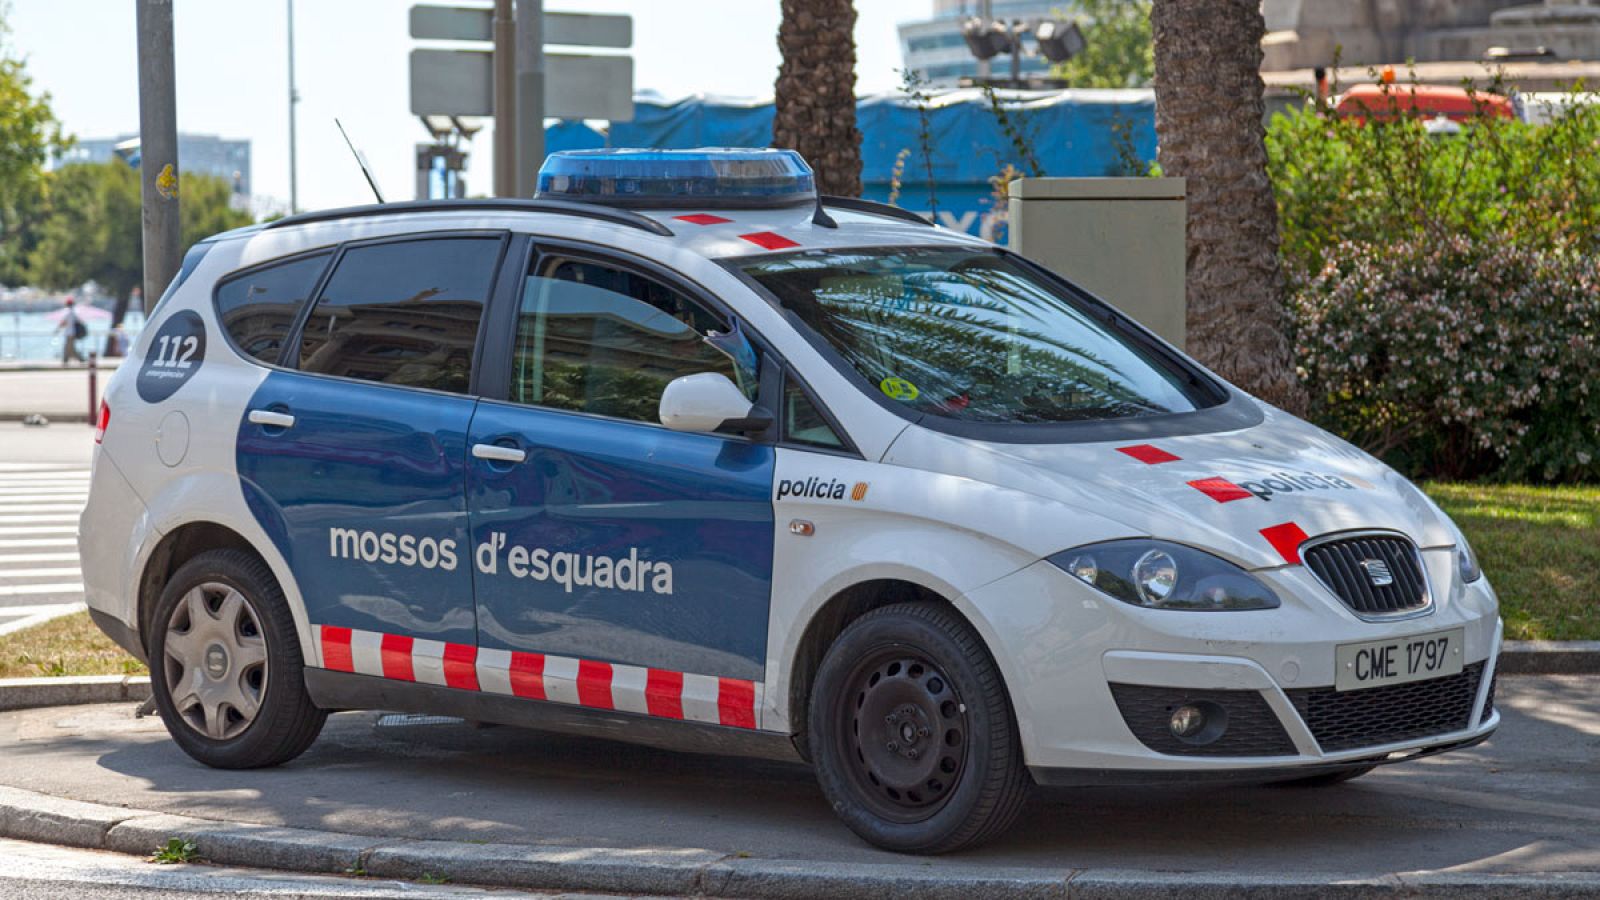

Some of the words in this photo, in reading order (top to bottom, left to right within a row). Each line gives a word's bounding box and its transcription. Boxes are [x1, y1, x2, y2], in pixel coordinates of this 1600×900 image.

[152, 335, 198, 369] 112
[776, 476, 846, 501] policia
[1238, 471, 1356, 501] policia
[330, 527, 458, 571] mossos
[475, 531, 674, 595] d'esquadra
[1355, 645, 1398, 681] CME
[1406, 637, 1449, 675] 1797
